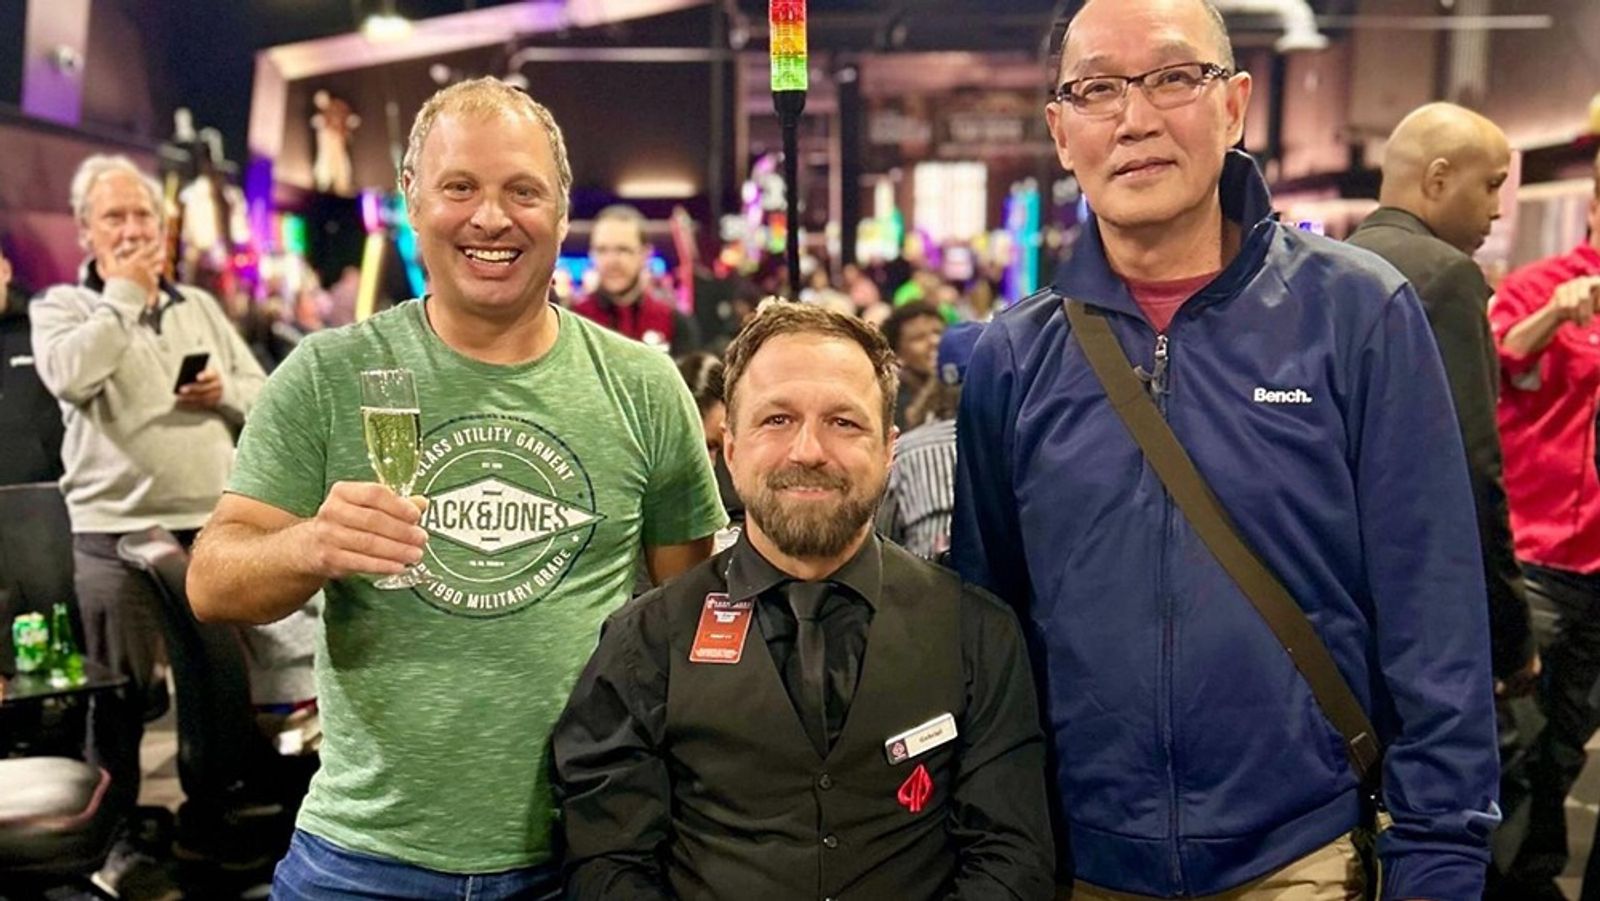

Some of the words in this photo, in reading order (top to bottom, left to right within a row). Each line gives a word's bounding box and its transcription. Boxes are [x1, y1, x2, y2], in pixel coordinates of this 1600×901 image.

[1254, 387, 1313, 403] Bench.
[416, 438, 452, 477] CLASS
[452, 427, 513, 446] UTILITY
[516, 432, 575, 480] GARMENT
[424, 499, 568, 532] ACK&JONES
[428, 581, 463, 605] 1990
[466, 581, 533, 609] MILITARY
[533, 548, 571, 588] GRADE
